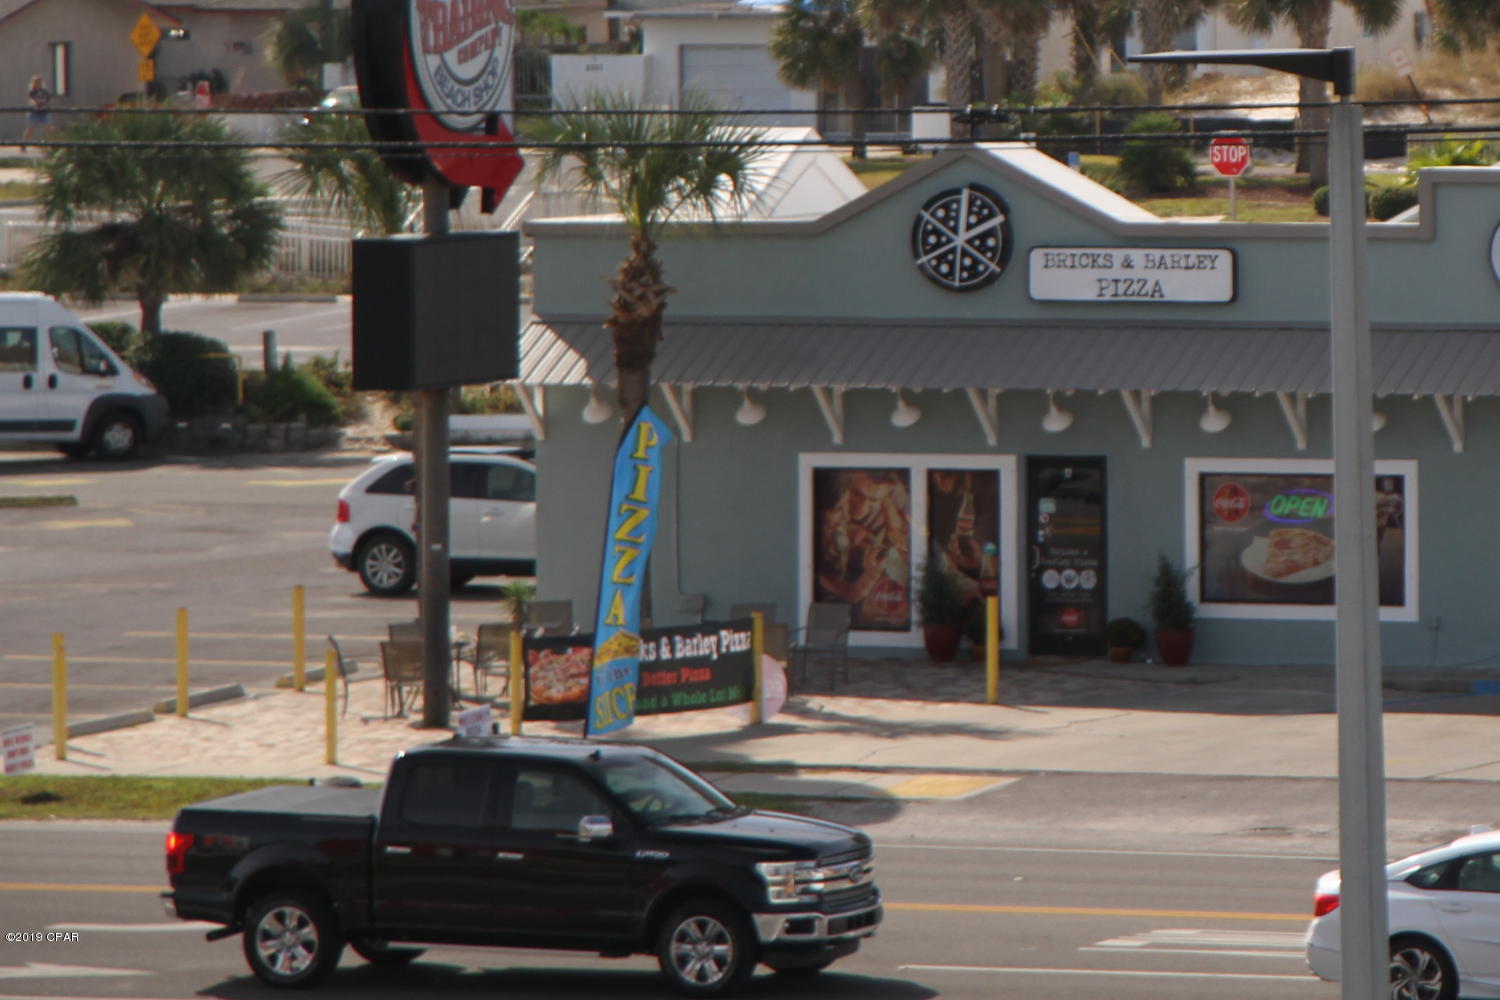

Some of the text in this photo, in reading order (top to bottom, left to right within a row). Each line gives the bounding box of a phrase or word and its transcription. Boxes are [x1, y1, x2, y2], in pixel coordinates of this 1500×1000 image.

[433, 56, 500, 109] BEACH SHOP
[1212, 144, 1247, 163] STOP
[1043, 252, 1220, 270] BRICKS & BARLEY
[1096, 278, 1165, 298] PIZZA
[1269, 494, 1330, 519] OPEN
[603, 421, 659, 626] PIZZA
[659, 636, 672, 660] &
[674, 632, 719, 661] Barley
